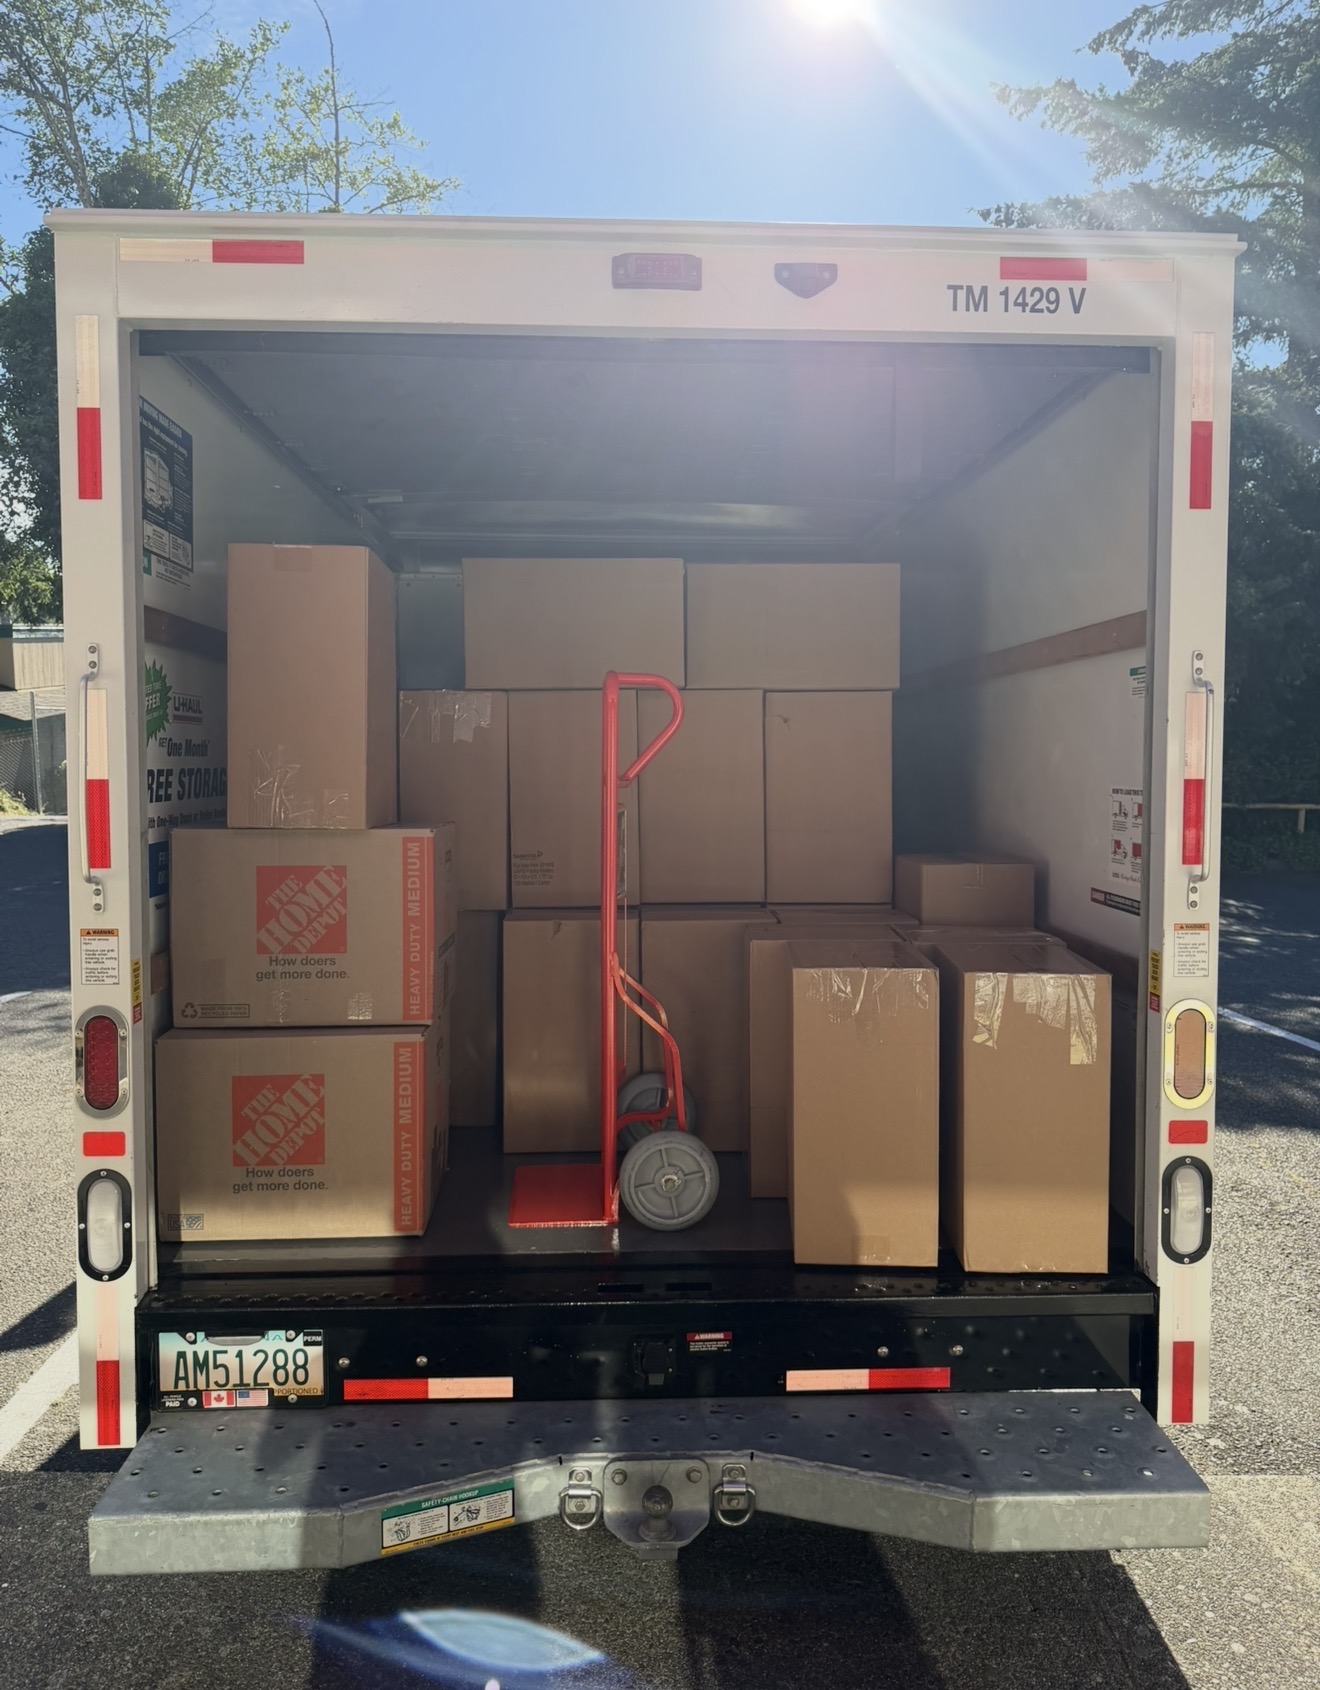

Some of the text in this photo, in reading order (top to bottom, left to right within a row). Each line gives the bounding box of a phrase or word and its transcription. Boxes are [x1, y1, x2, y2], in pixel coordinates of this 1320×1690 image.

[947, 284, 1086, 314] TM 1429 V
[146, 693, 160, 712] FFER
[168, 738, 182, 757] One
[148, 767, 227, 804] REE STORAG
[257, 865, 348, 955] HOME
[265, 874, 304, 912] THE
[290, 898, 348, 955] DEPOT
[407, 842, 421, 1015] HEAVY DUTY MEDIUM
[256, 968, 350, 982] get more done.
[268, 955, 336, 967] How doers
[233, 1073, 326, 1166] HOME
[242, 1084, 280, 1122] THE
[268, 1107, 325, 1166] DEPOT
[398, 1047, 412, 1225] HEAVY DUTY MEDIUM
[232, 1180, 328, 1194] get more done.
[246, 1167, 314, 1178] How doers
[169, 1219, 185, 1229] USA
[174, 1348, 310, 1390] AM51288
[274, 1387, 318, 1395] PPORTIONED
